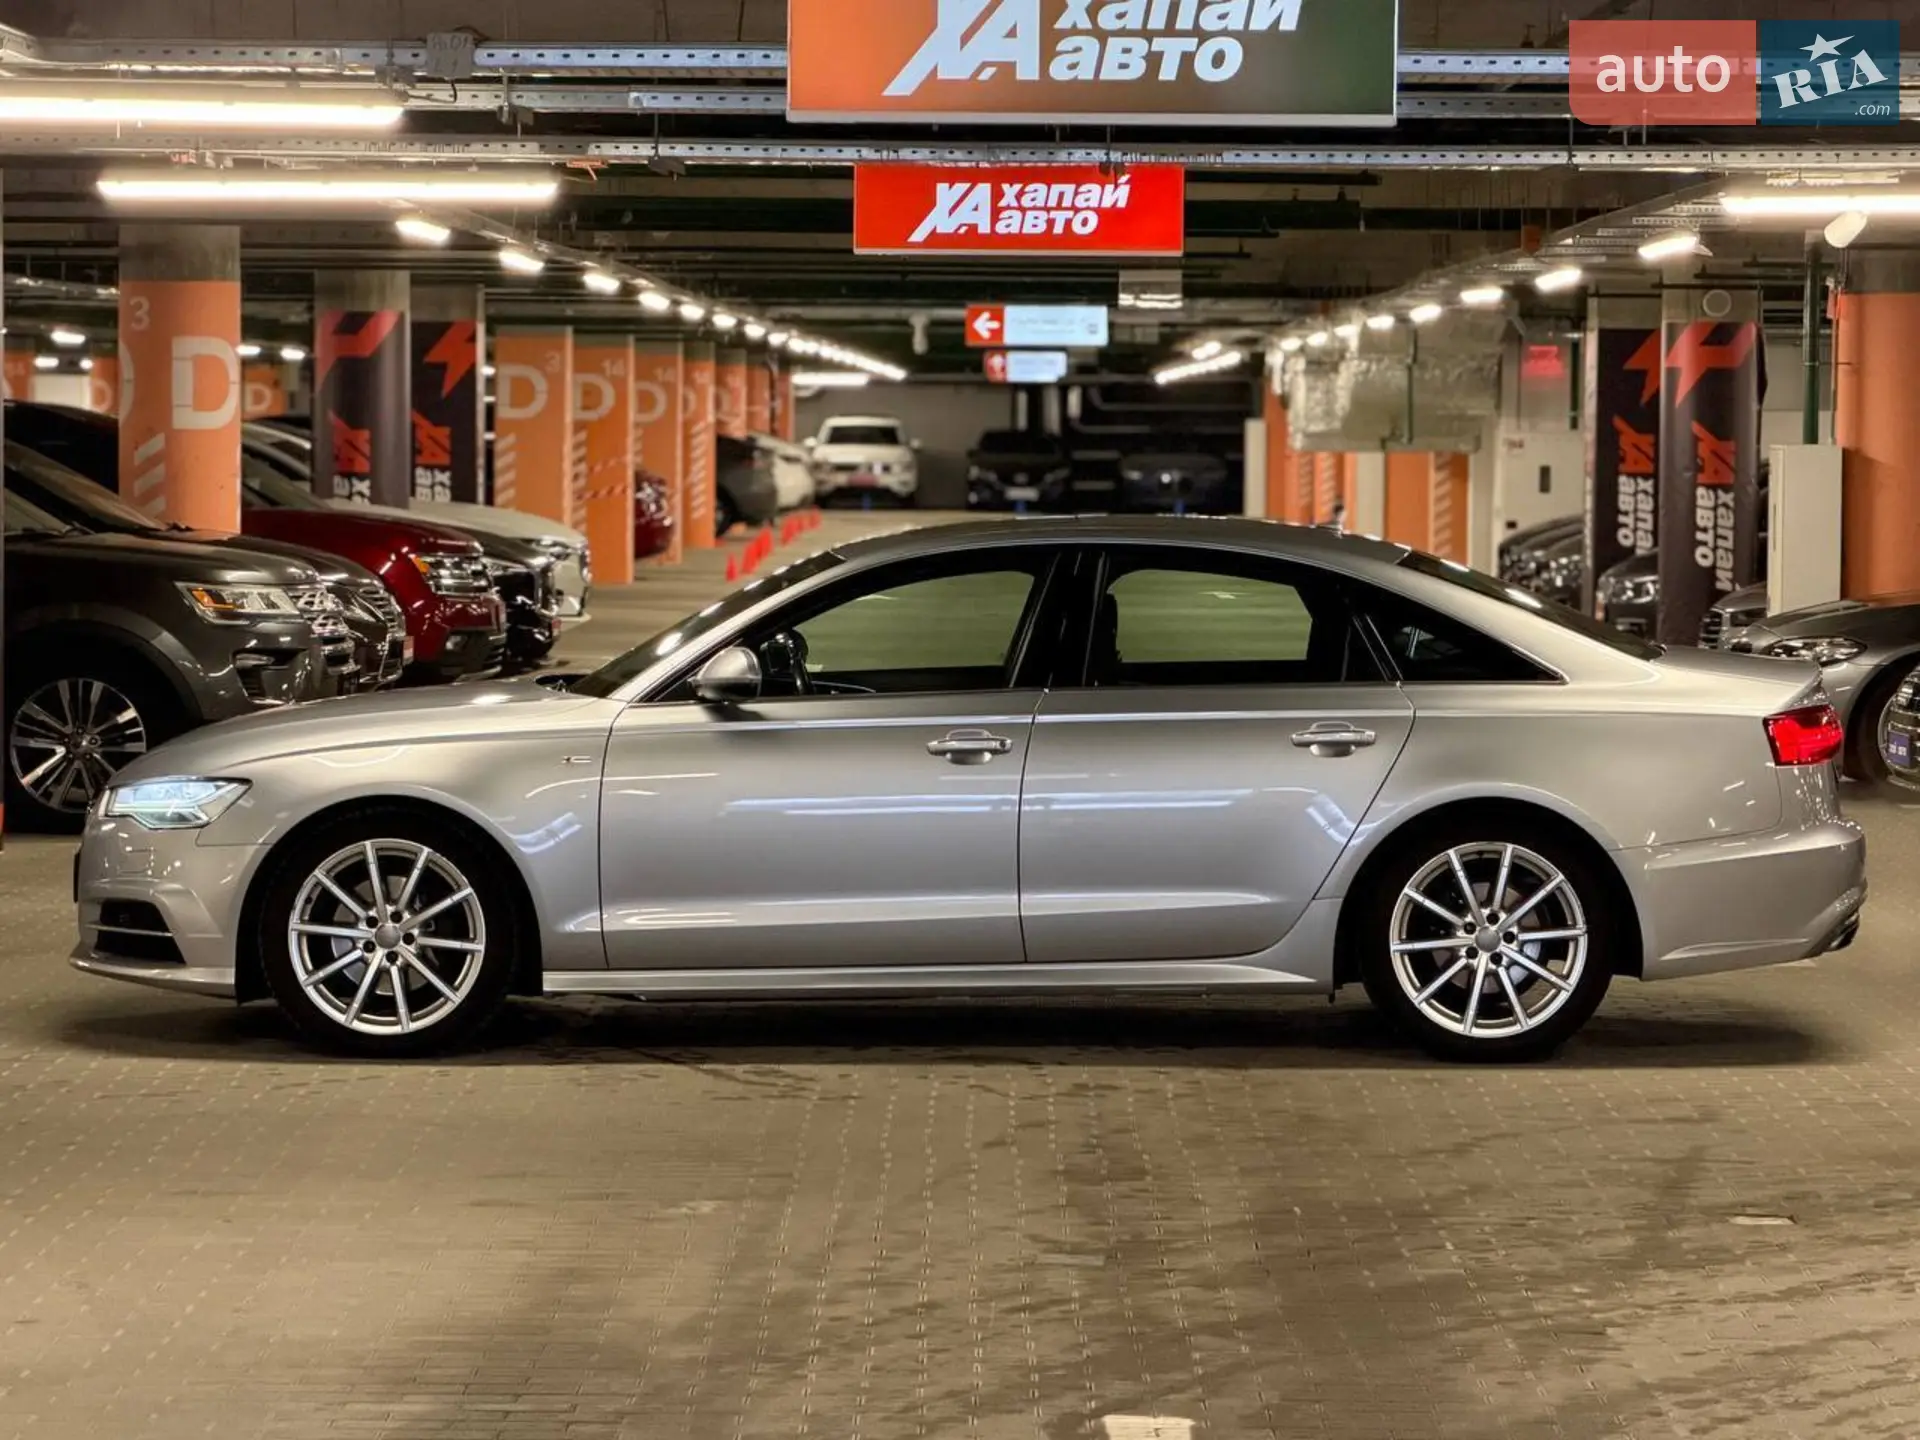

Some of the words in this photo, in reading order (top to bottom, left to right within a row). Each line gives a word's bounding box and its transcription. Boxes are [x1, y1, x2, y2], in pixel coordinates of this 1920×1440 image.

[1049, 36, 1244, 82] авто
[997, 174, 1131, 209] хапай
[995, 210, 1099, 235] авто
[129, 296, 151, 330] 3
[172, 335, 241, 430] D
[497, 364, 549, 419] D
[573, 374, 617, 420] D
[1617, 474, 1636, 547] авто
[1695, 486, 1716, 567] авто
